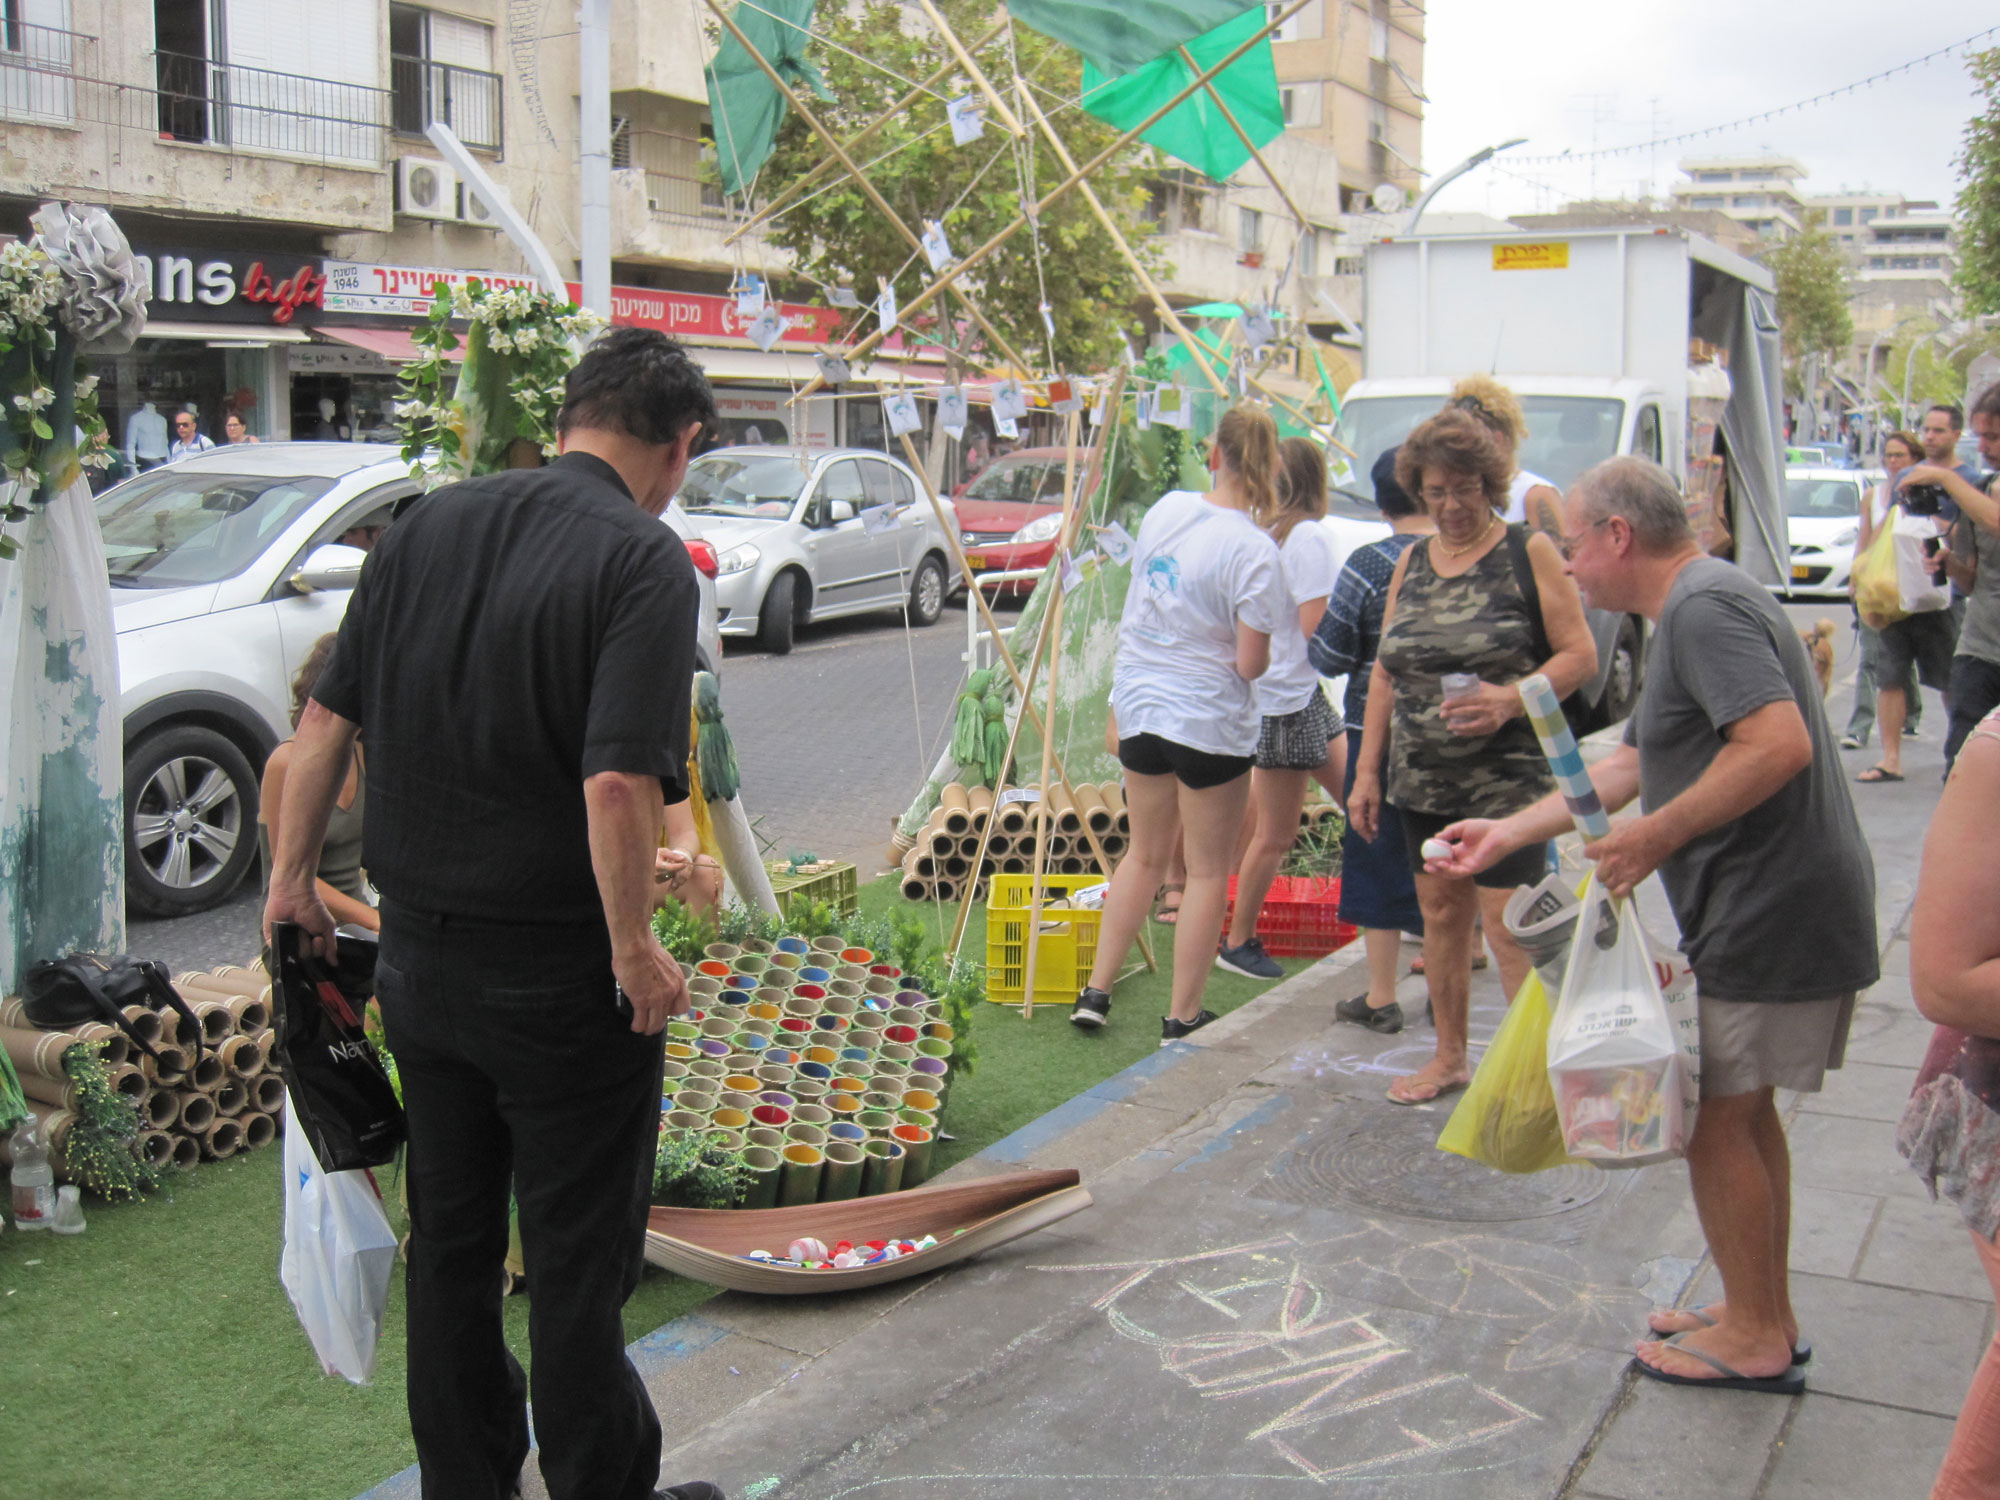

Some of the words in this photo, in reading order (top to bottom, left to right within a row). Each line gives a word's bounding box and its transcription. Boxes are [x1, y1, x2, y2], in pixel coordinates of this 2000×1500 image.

[334, 277, 360, 290] 1946
[610, 297, 664, 320] שמיעה
[669, 302, 701, 328] מכון
